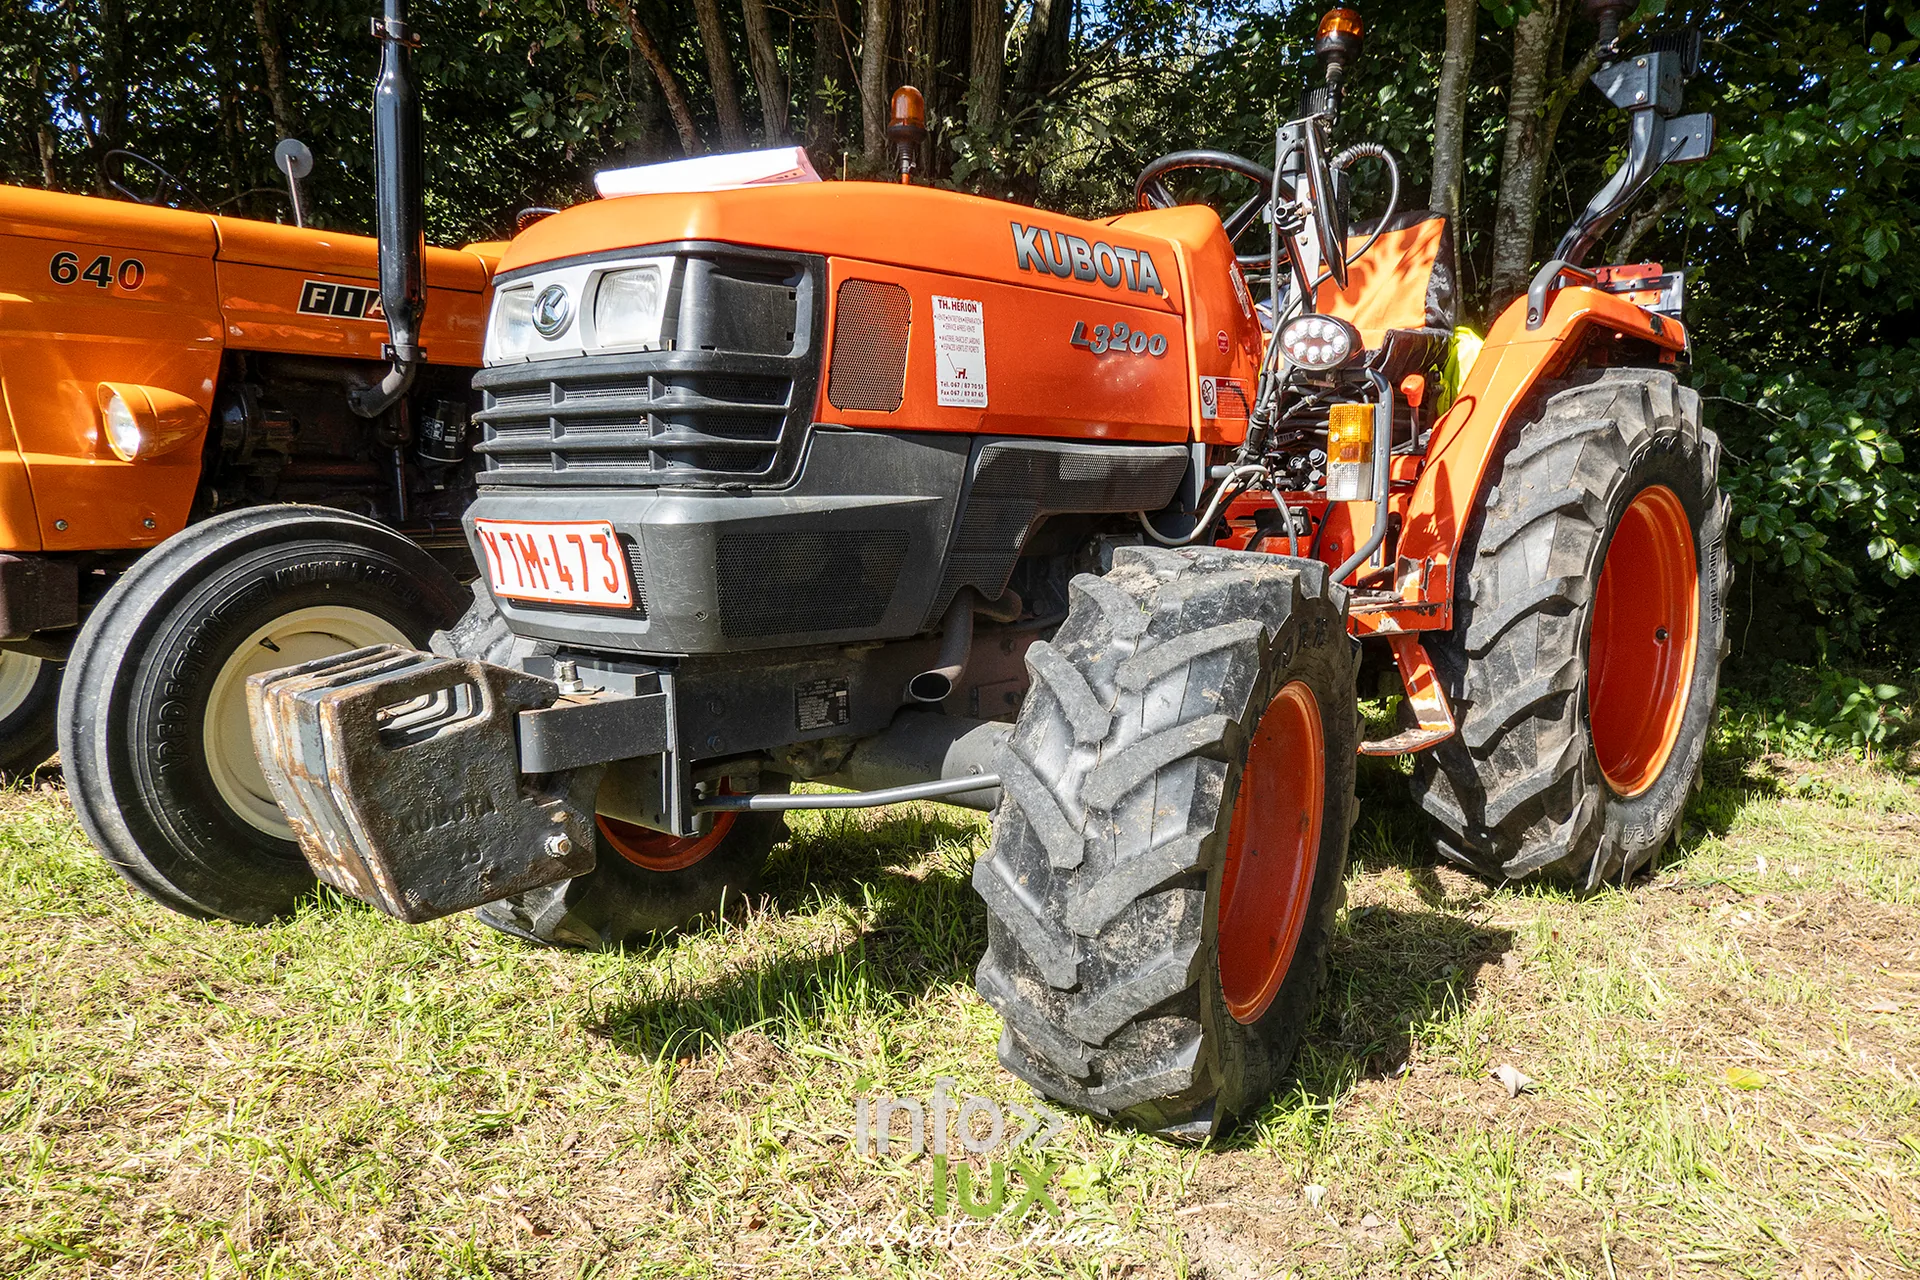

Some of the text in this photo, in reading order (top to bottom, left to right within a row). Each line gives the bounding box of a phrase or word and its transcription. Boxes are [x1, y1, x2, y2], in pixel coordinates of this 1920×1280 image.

[49, 251, 146, 291] 640
[1010, 221, 1164, 296] KUBOTA
[308, 287, 386, 316] FIA
[1069, 320, 1168, 357] L3200
[157, 612, 234, 773] VREDESTEIN
